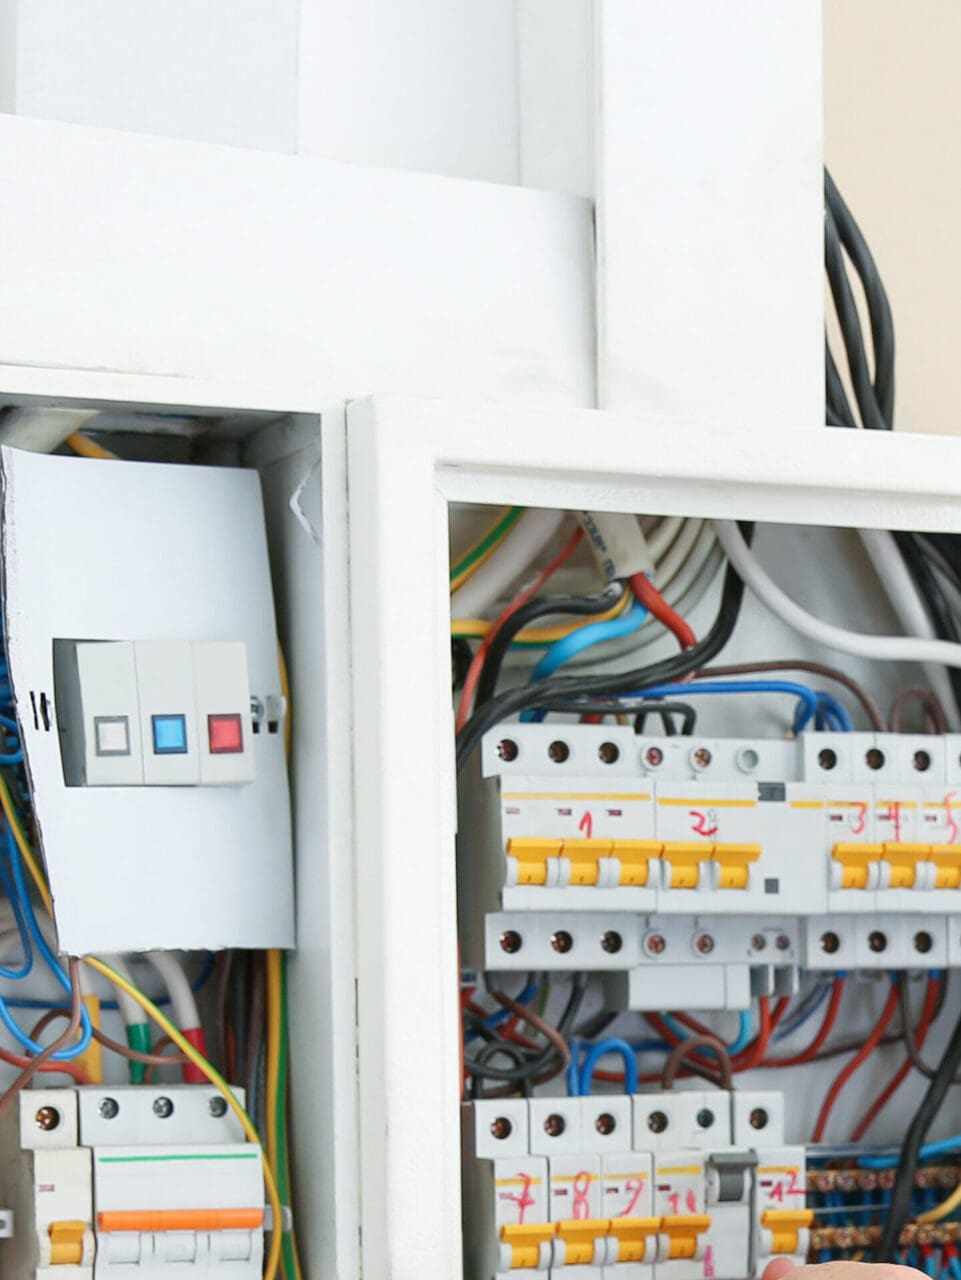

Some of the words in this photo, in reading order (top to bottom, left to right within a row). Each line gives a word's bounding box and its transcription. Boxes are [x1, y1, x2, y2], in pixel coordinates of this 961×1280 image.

[579, 810, 592, 839] 1
[689, 810, 718, 836] 2
[851, 801, 868, 834] 3
[511, 1172, 535, 1224] 7
[573, 1171, 591, 1220] 8
[620, 1178, 643, 1216] 9
[769, 1171, 806, 1201] 12
